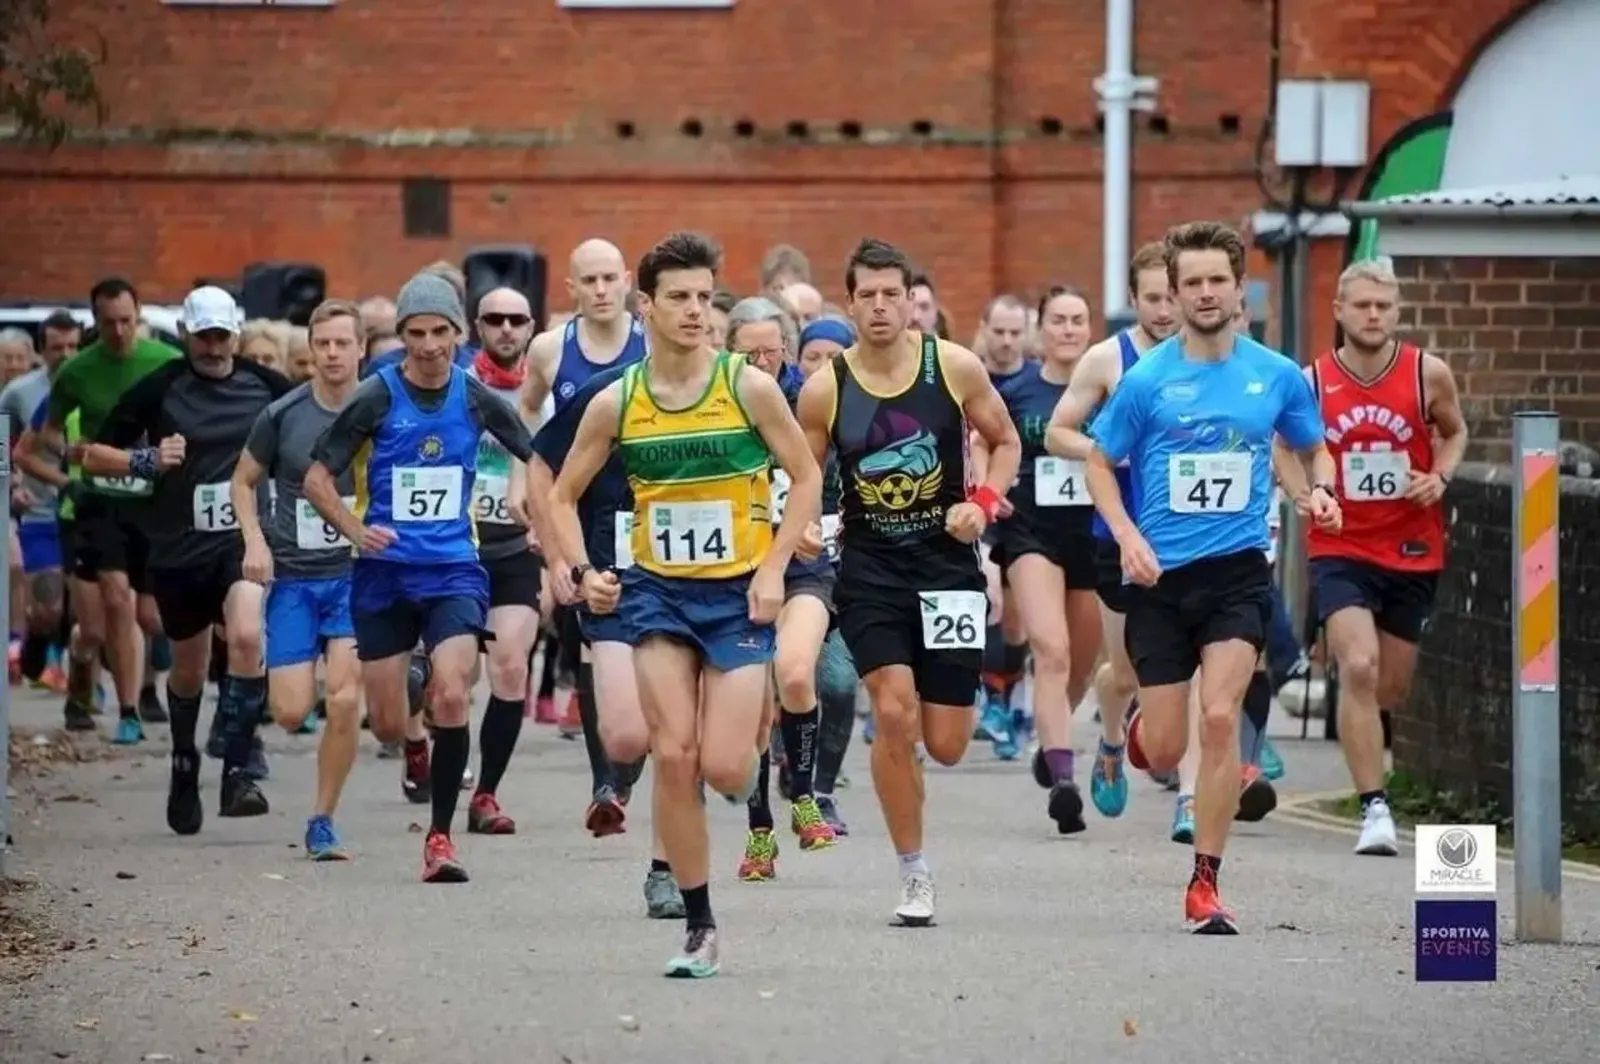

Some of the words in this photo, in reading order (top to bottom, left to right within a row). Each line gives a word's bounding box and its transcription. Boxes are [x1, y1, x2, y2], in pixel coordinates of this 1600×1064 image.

[1325, 404, 1413, 444] RAPTORS
[638, 439, 728, 464] CORNWALL
[1058, 475, 1077, 501] 4
[1187, 478, 1233, 508] 47
[1358, 472, 1396, 496] 46
[202, 502, 237, 528] 13
[408, 489, 448, 516] 57
[477, 494, 510, 519] 98
[656, 528, 727, 561] 114
[933, 613, 976, 644] 26
